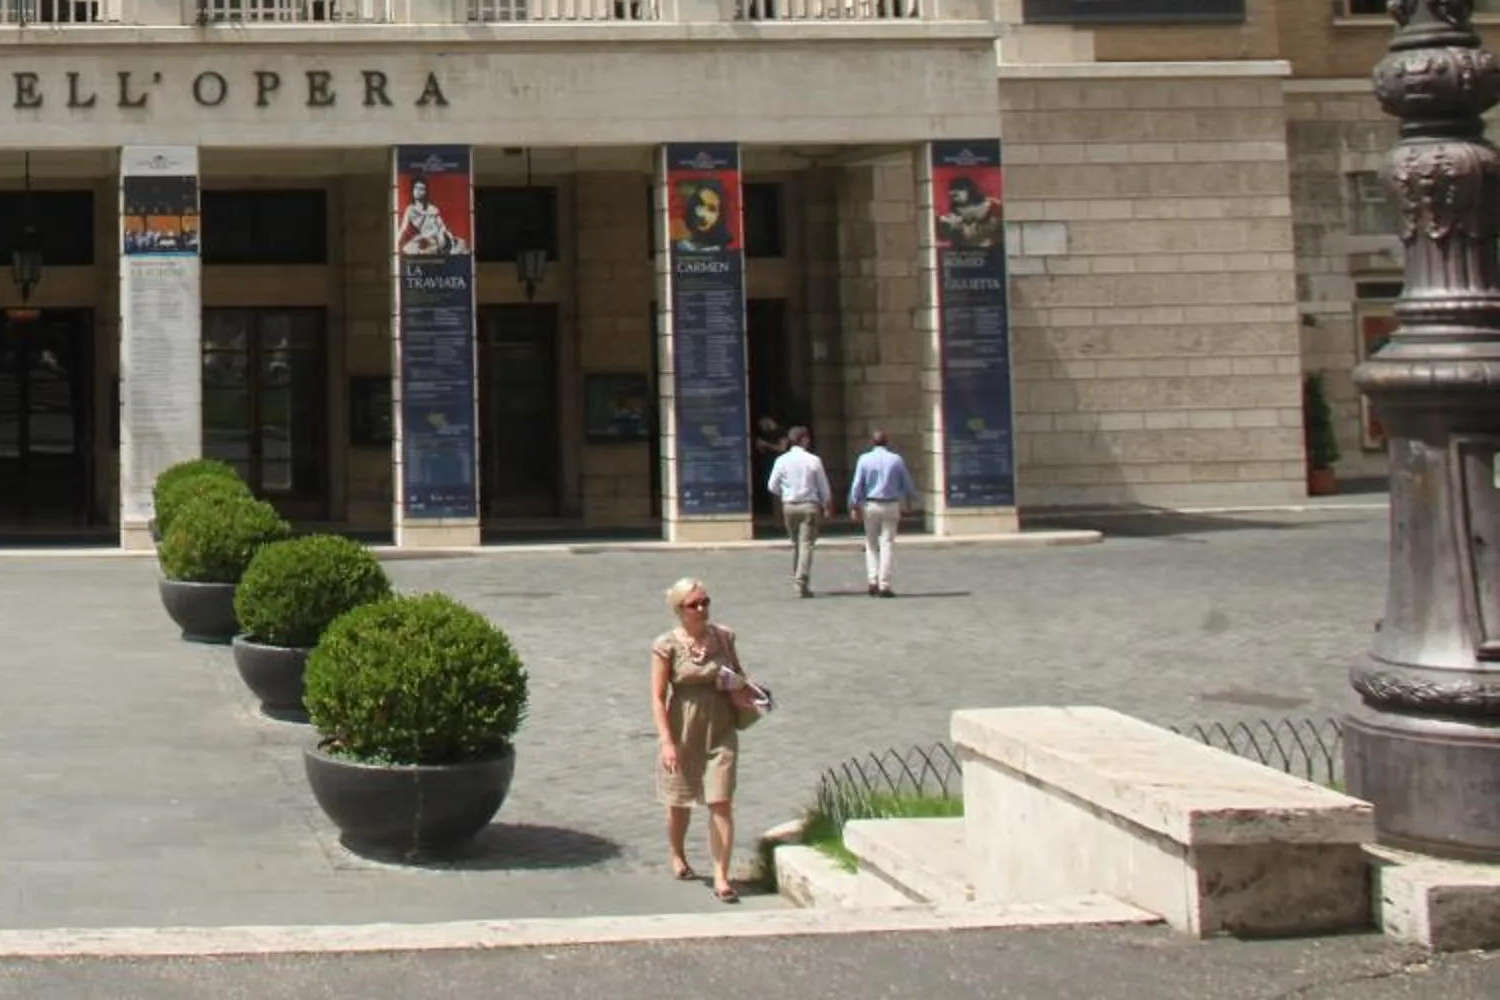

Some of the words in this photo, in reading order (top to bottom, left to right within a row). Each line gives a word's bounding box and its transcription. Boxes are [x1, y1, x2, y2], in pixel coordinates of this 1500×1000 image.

[406, 265, 423, 277] LA
[676, 262, 730, 273] CARMEN
[406, 276, 467, 290] TRAVIATA
